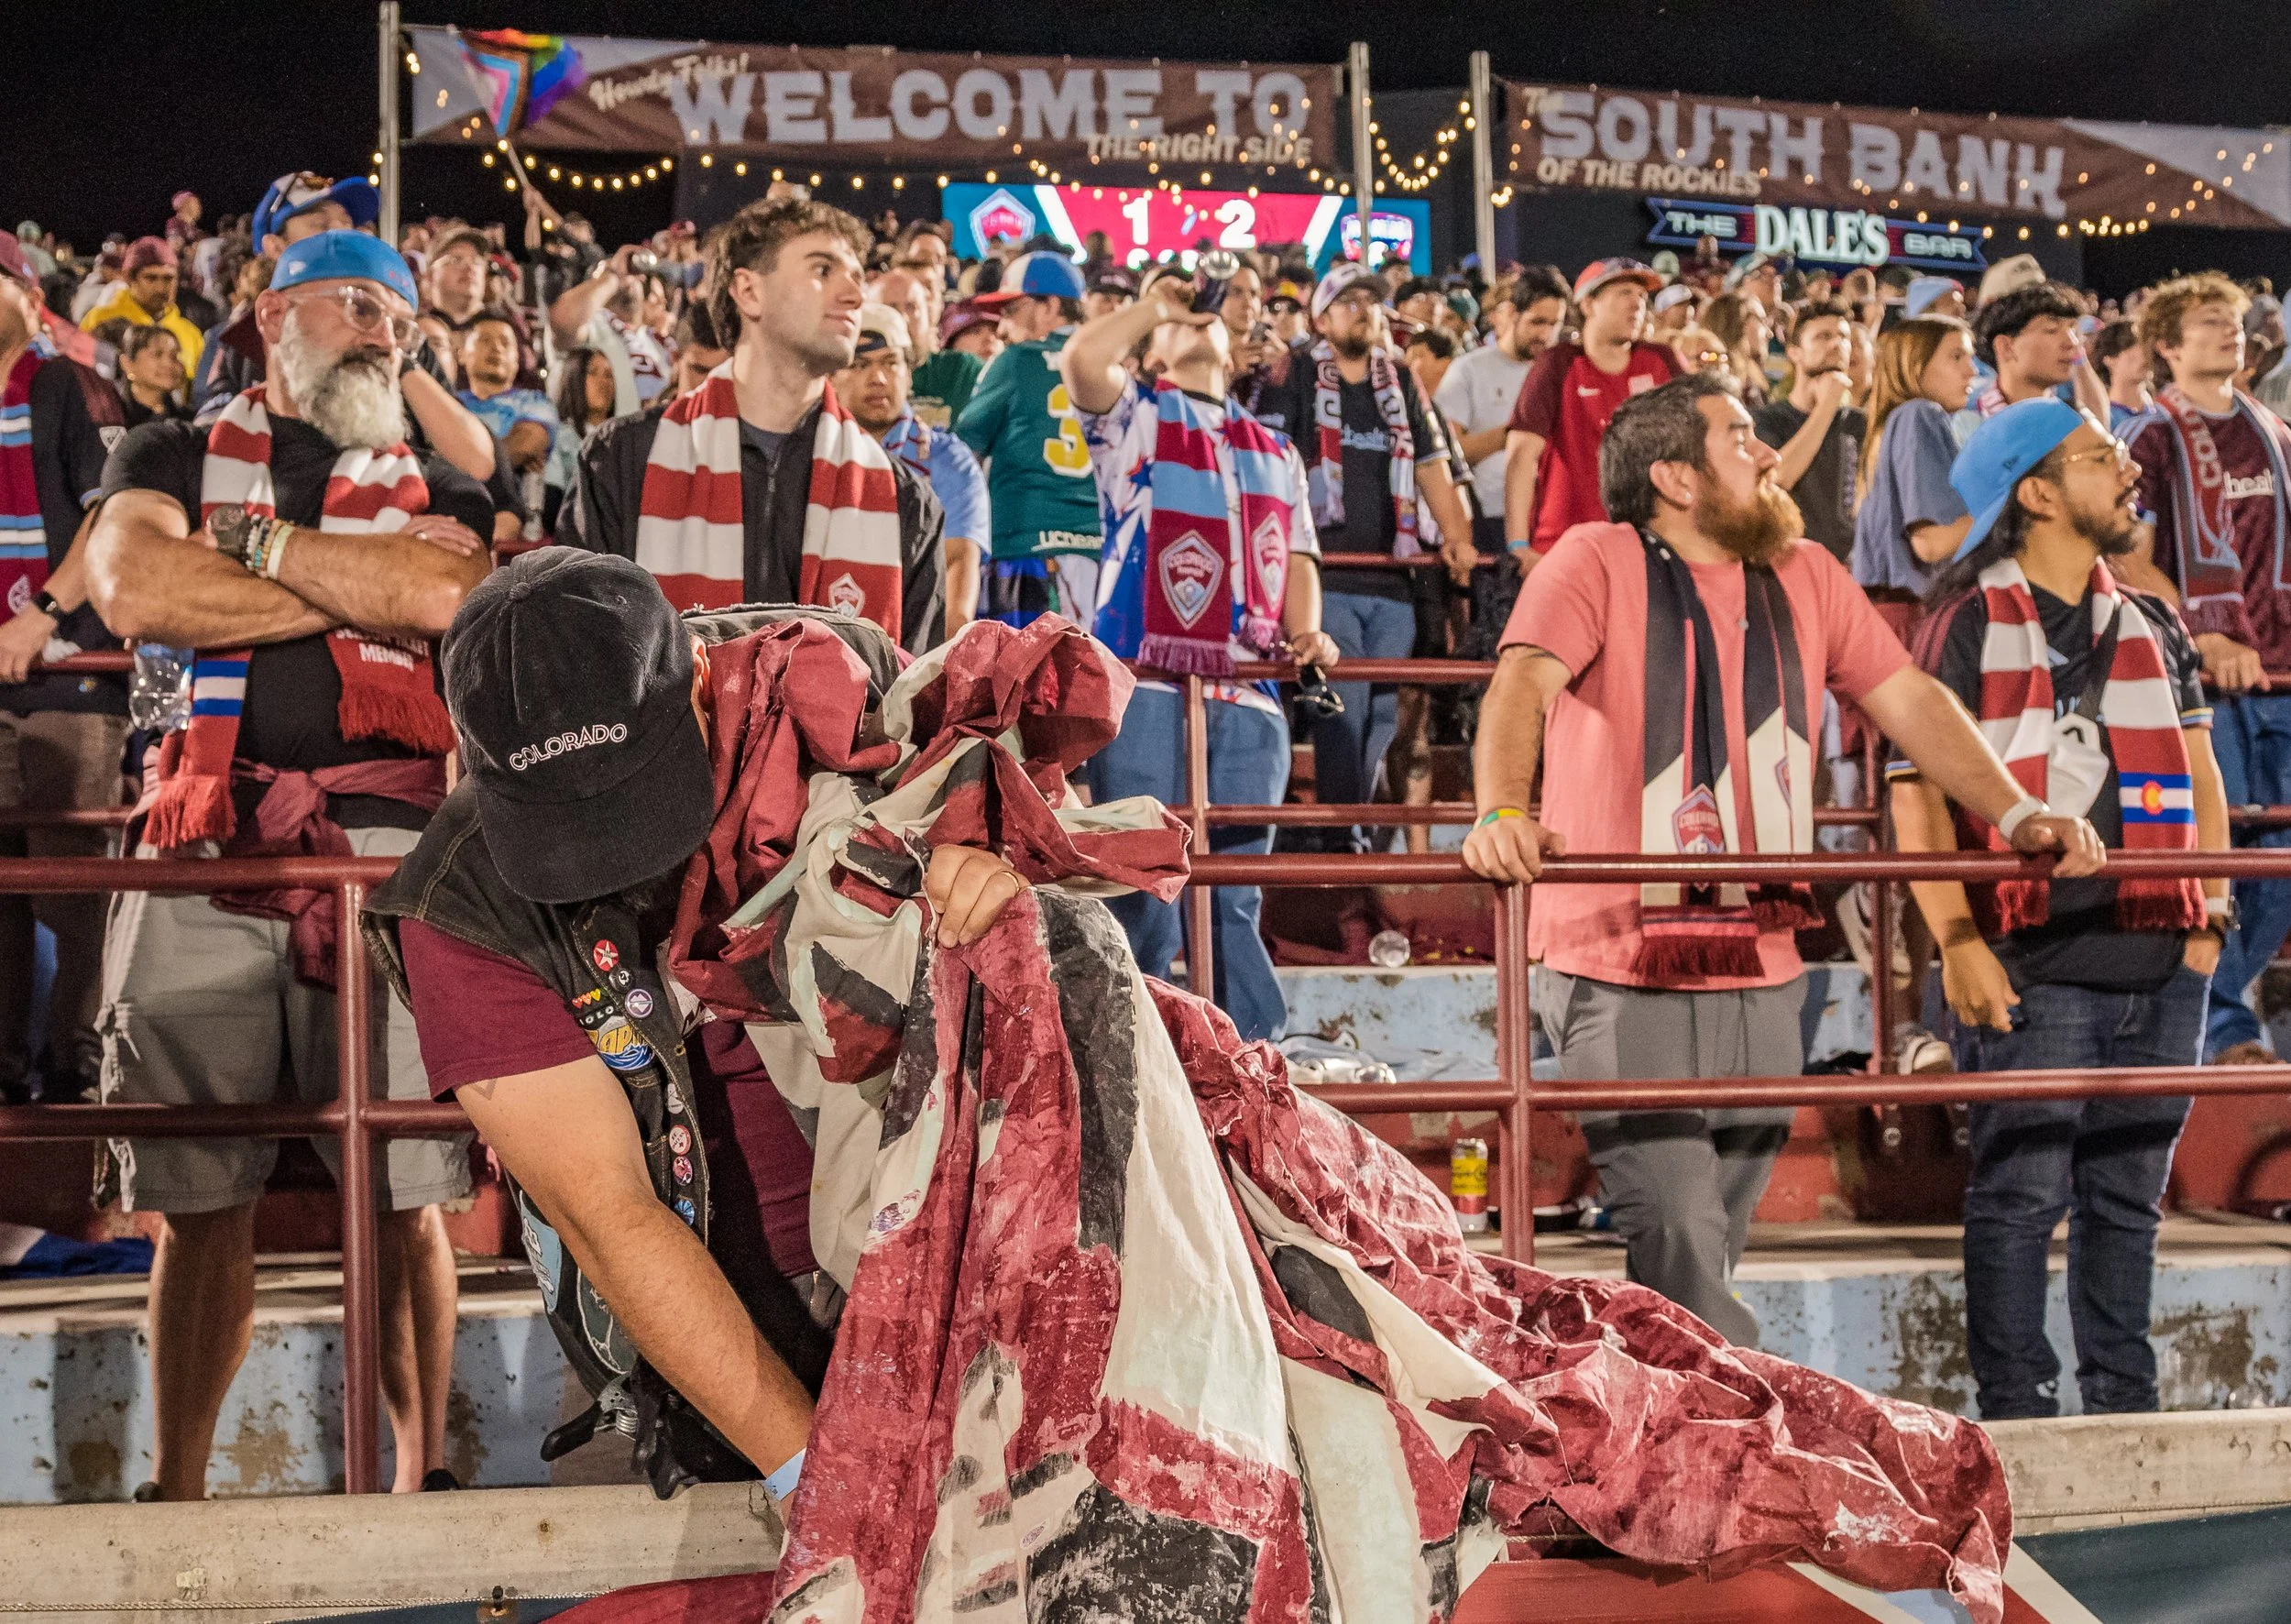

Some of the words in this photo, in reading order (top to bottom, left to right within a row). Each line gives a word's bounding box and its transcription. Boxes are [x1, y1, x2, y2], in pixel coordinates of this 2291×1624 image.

[671, 67, 1163, 145] WELCOME
[1196, 69, 1308, 139] TO
[1085, 131, 1142, 159] THE
[1147, 135, 1238, 162] RIGHT
[1244, 137, 1313, 163] SIDE
[1539, 91, 1824, 181] SOUTH
[1847, 123, 2066, 219] BANK
[1537, 158, 1576, 184] OF
[1581, 159, 1637, 188] THE
[1641, 163, 1761, 197] ROCKIES
[1122, 197, 1149, 245] 1
[1219, 199, 1256, 248] 2
[1665, 211, 1737, 237] THE
[1754, 204, 1891, 266] DALE'S
[1903, 233, 1973, 258] BAR
[510, 723, 628, 771] COLORADO
